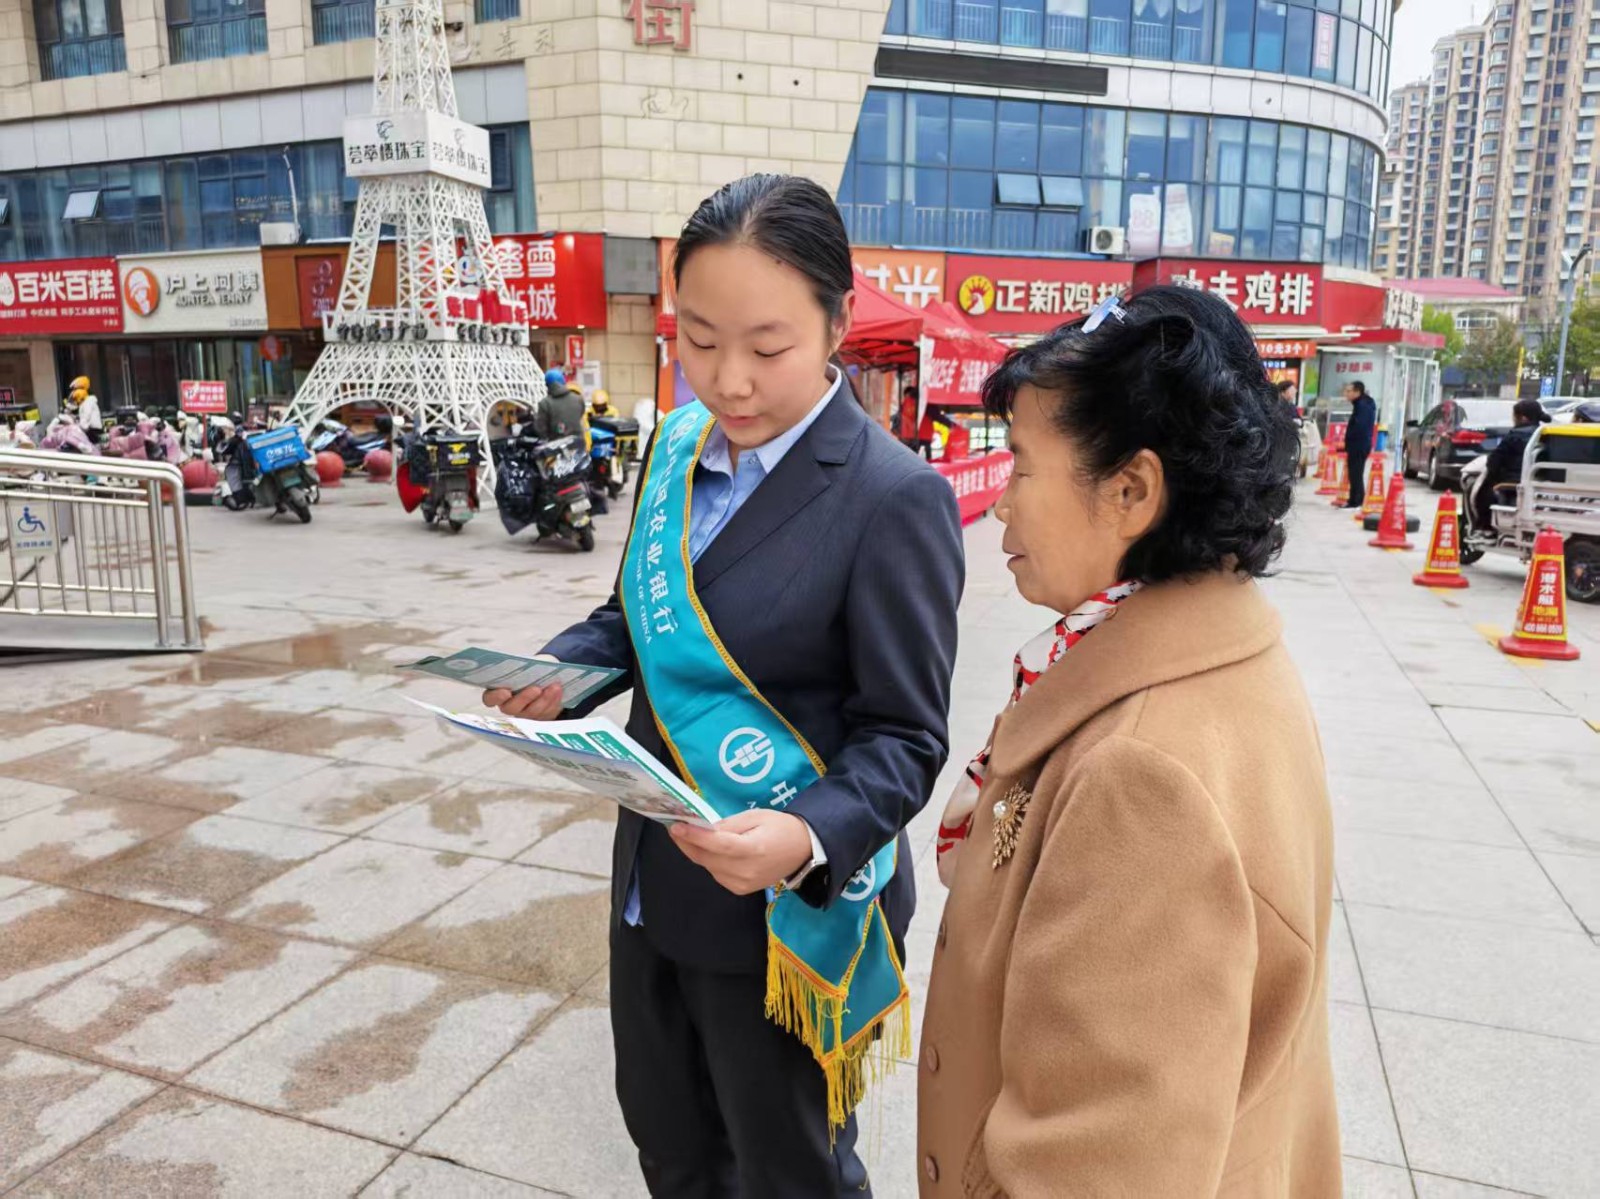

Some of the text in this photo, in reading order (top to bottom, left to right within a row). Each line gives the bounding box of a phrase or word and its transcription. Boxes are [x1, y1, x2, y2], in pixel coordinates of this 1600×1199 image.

[624, 0, 695, 49] 街
[348, 140, 425, 164] 荟萃楼珠宝
[494, 239, 556, 279] 蜜雪
[14, 269, 116, 303] 百米百糕
[165, 271, 259, 295] 沪上阿姨
[646, 452, 679, 635] 中国农业银行
[640, 604, 652, 644] CHINA
